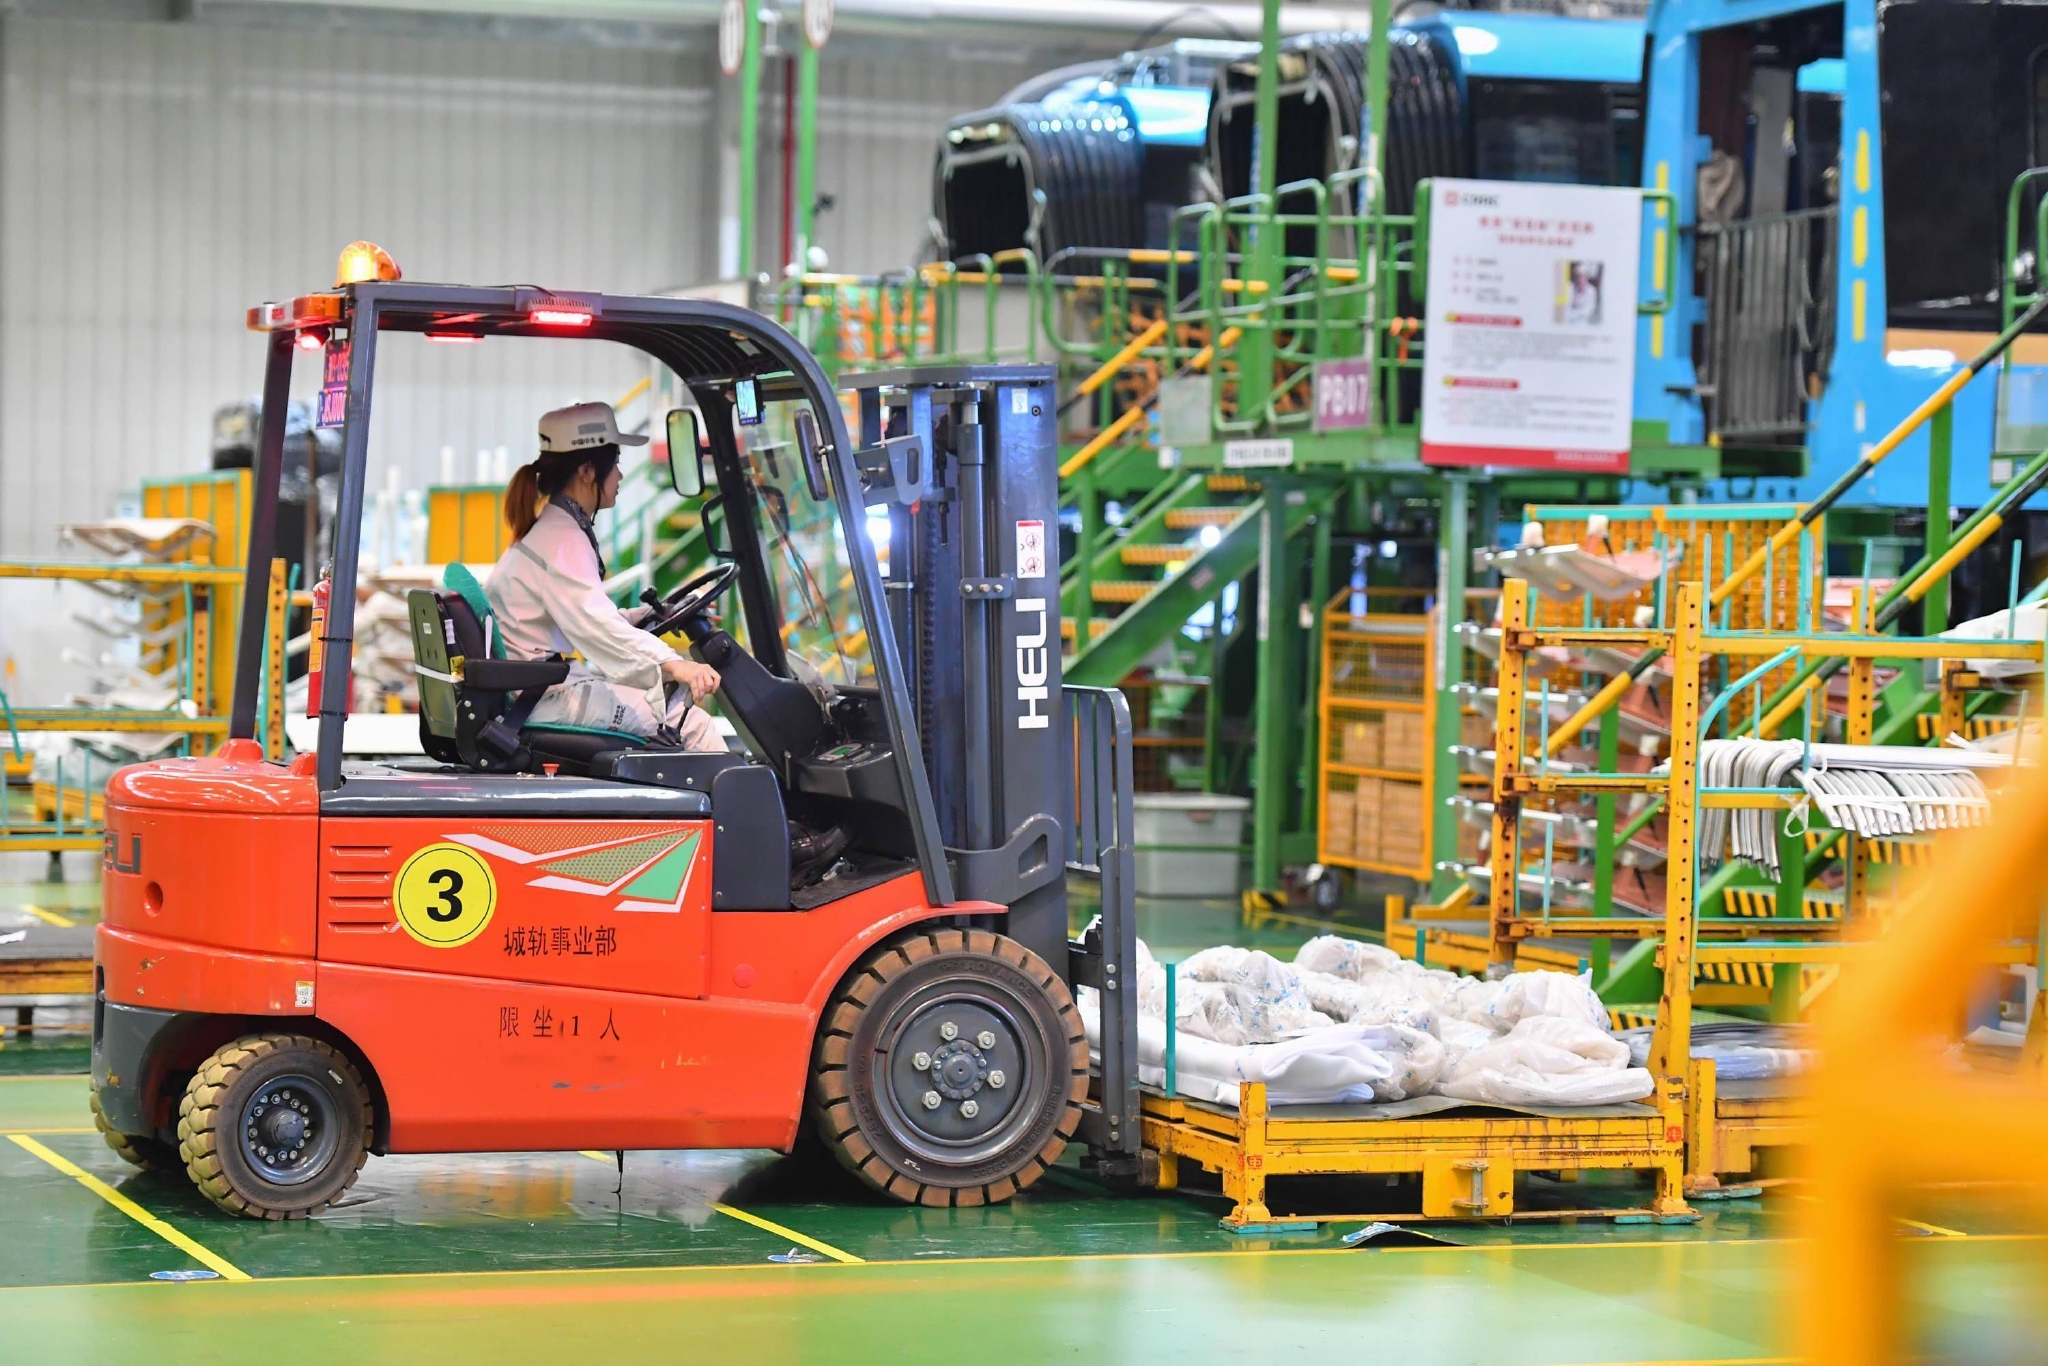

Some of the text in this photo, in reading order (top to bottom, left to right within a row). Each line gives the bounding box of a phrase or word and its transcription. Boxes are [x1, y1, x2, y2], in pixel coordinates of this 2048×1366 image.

[1319, 374, 1368, 417] PB07
[1016, 598, 1048, 729] HELI
[426, 869, 463, 922] 3
[504, 924, 617, 956] 城轨事业部
